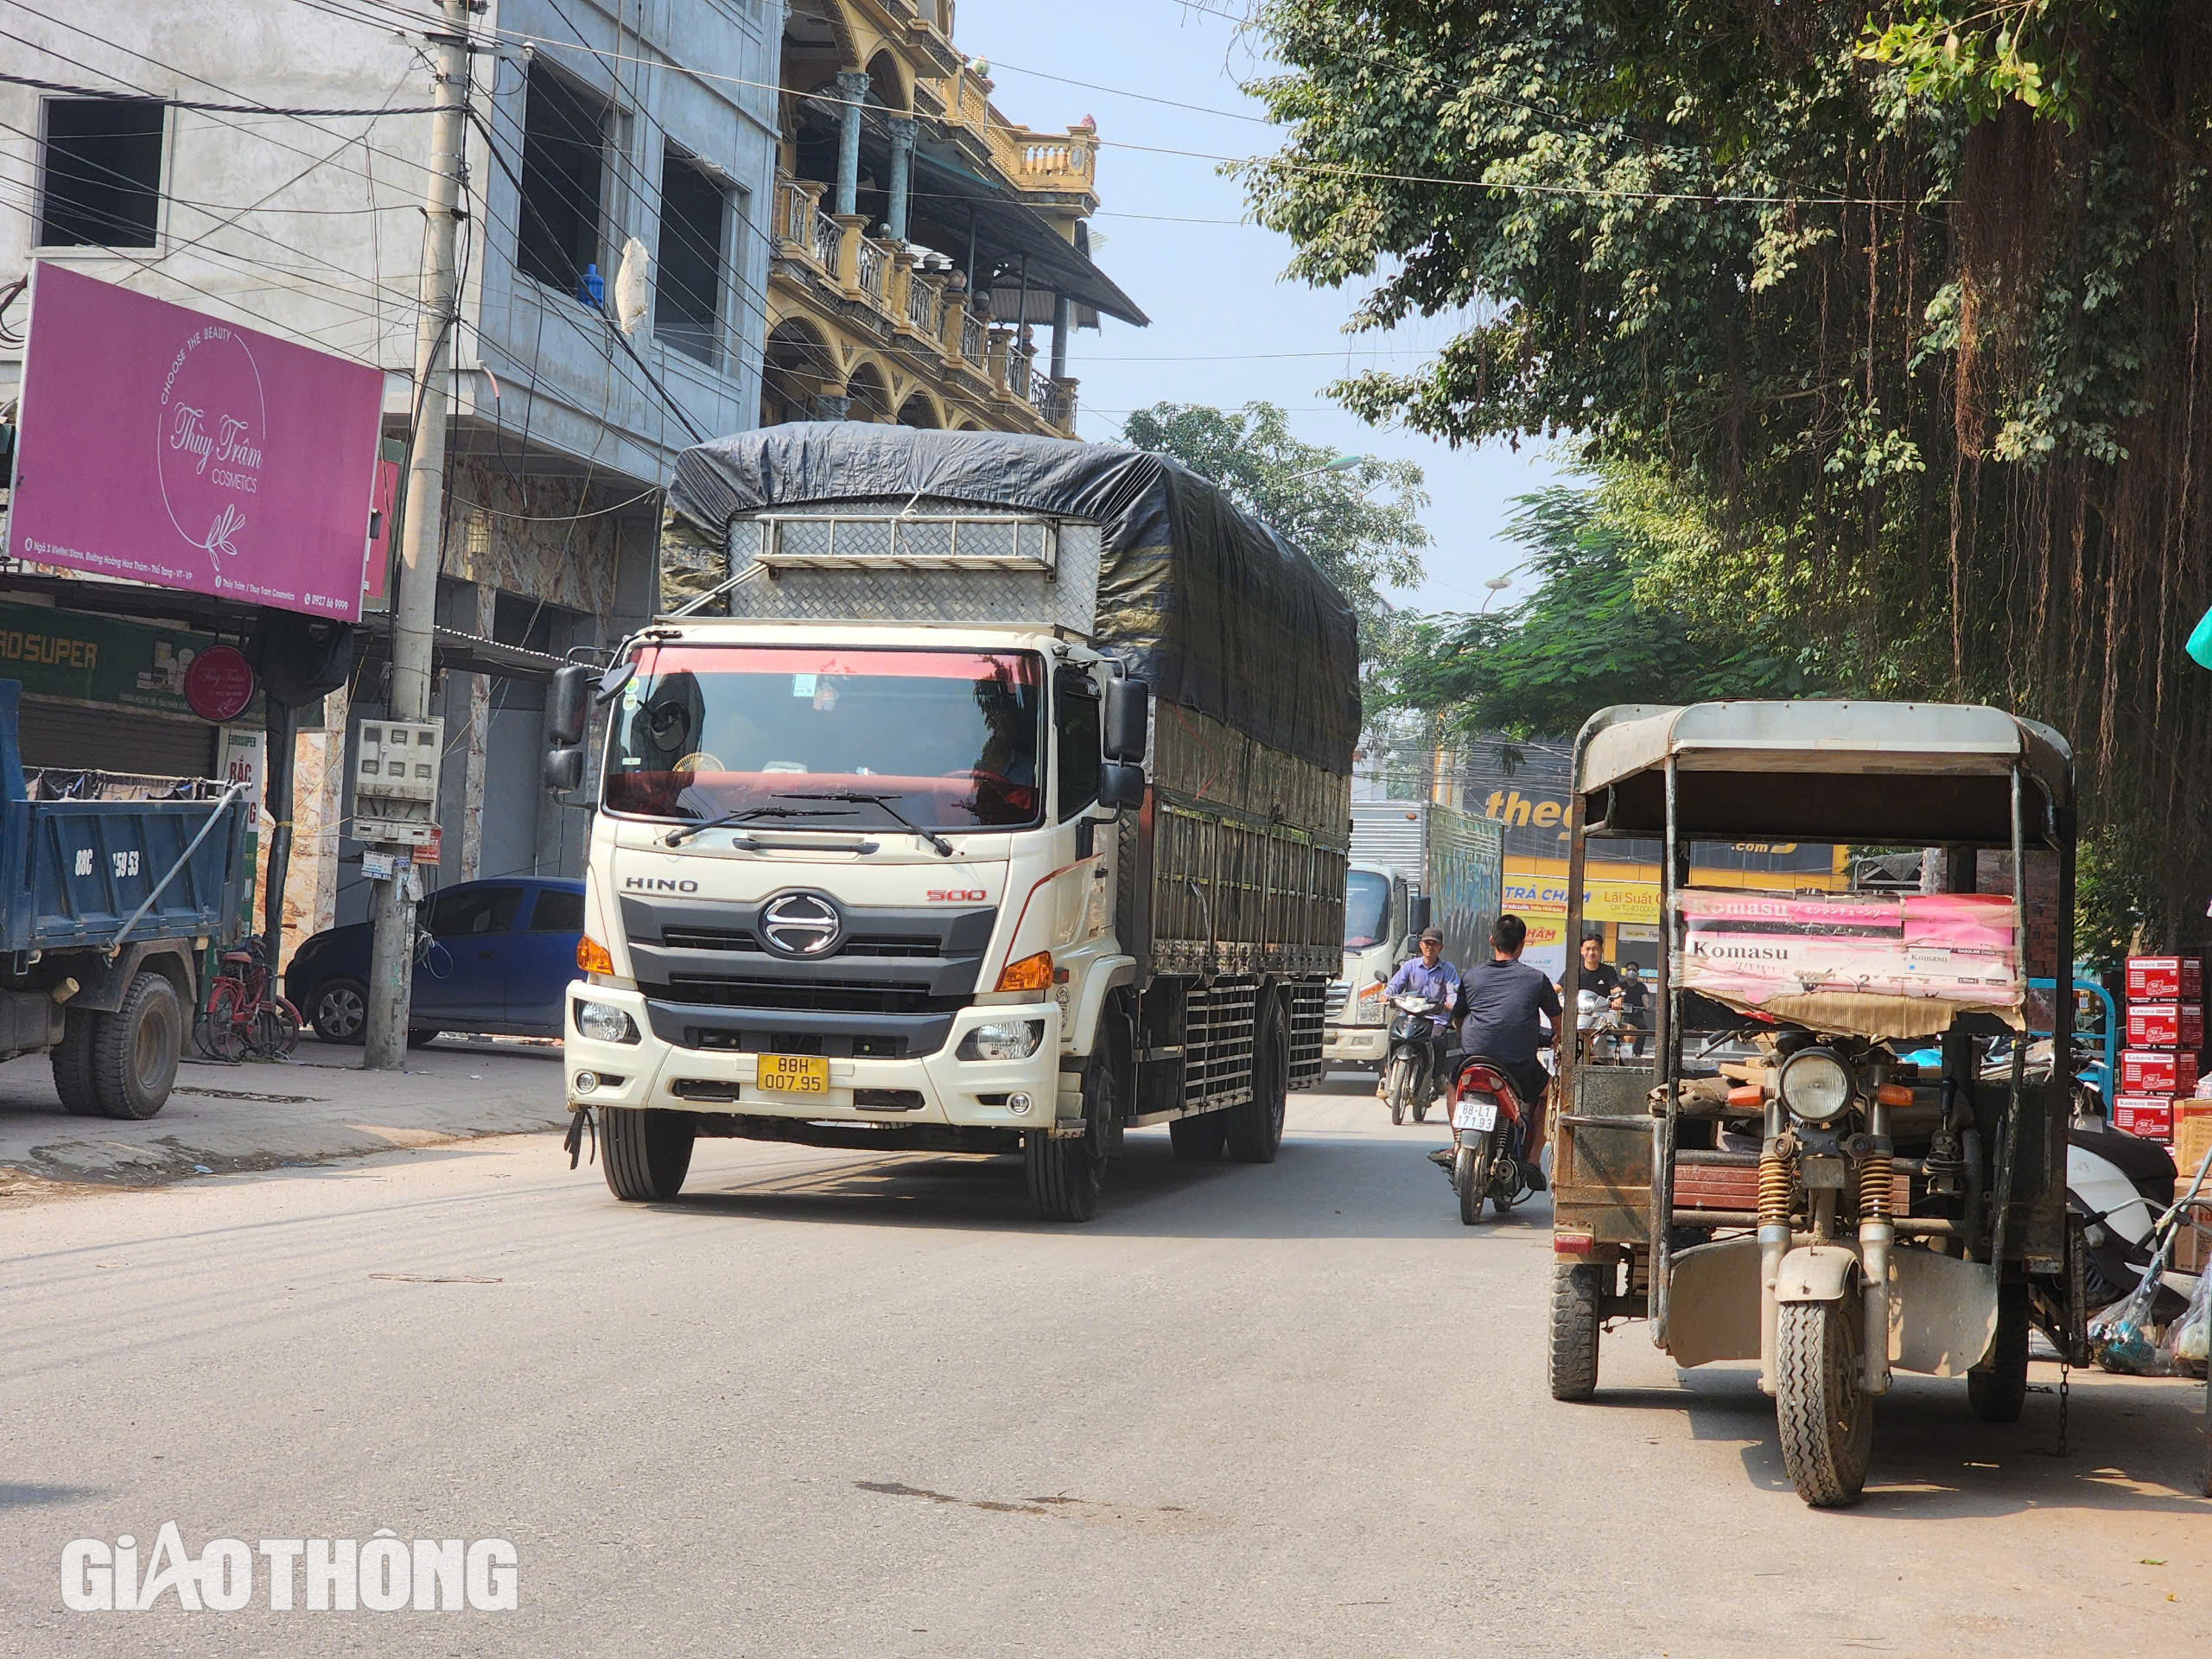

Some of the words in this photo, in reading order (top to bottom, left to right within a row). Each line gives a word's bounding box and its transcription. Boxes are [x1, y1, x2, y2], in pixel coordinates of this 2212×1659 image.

[161, 348, 186, 405] CHOOSE
[187, 332, 201, 352] THE
[204, 326, 232, 342] BEAUTY
[212, 467, 257, 493] COSMETICS
[311, 594, 325, 607] 0927
[326, 596, 334, 607] 66
[334, 599, 349, 611] 9999
[227, 734, 257, 748] EUROSUPER
[75, 849, 93, 877] 88C
[626, 876, 699, 893] HINO
[926, 888, 987, 902] 500
[1504, 884, 1536, 899] TRẢ
[1541, 888, 1592, 904] CHM
[1604, 891, 1622, 903] Lãi
[1624, 891, 1652, 905] Suất
[1694, 940, 1789, 960] Komasu
[1911, 953, 1948, 963] Komasu
[779, 1058, 809, 1074] 88H
[766, 1074, 821, 1091] 007.95
[1463, 1104, 1490, 1118] 88-L1
[1458, 1115, 1492, 1129] 171.93
